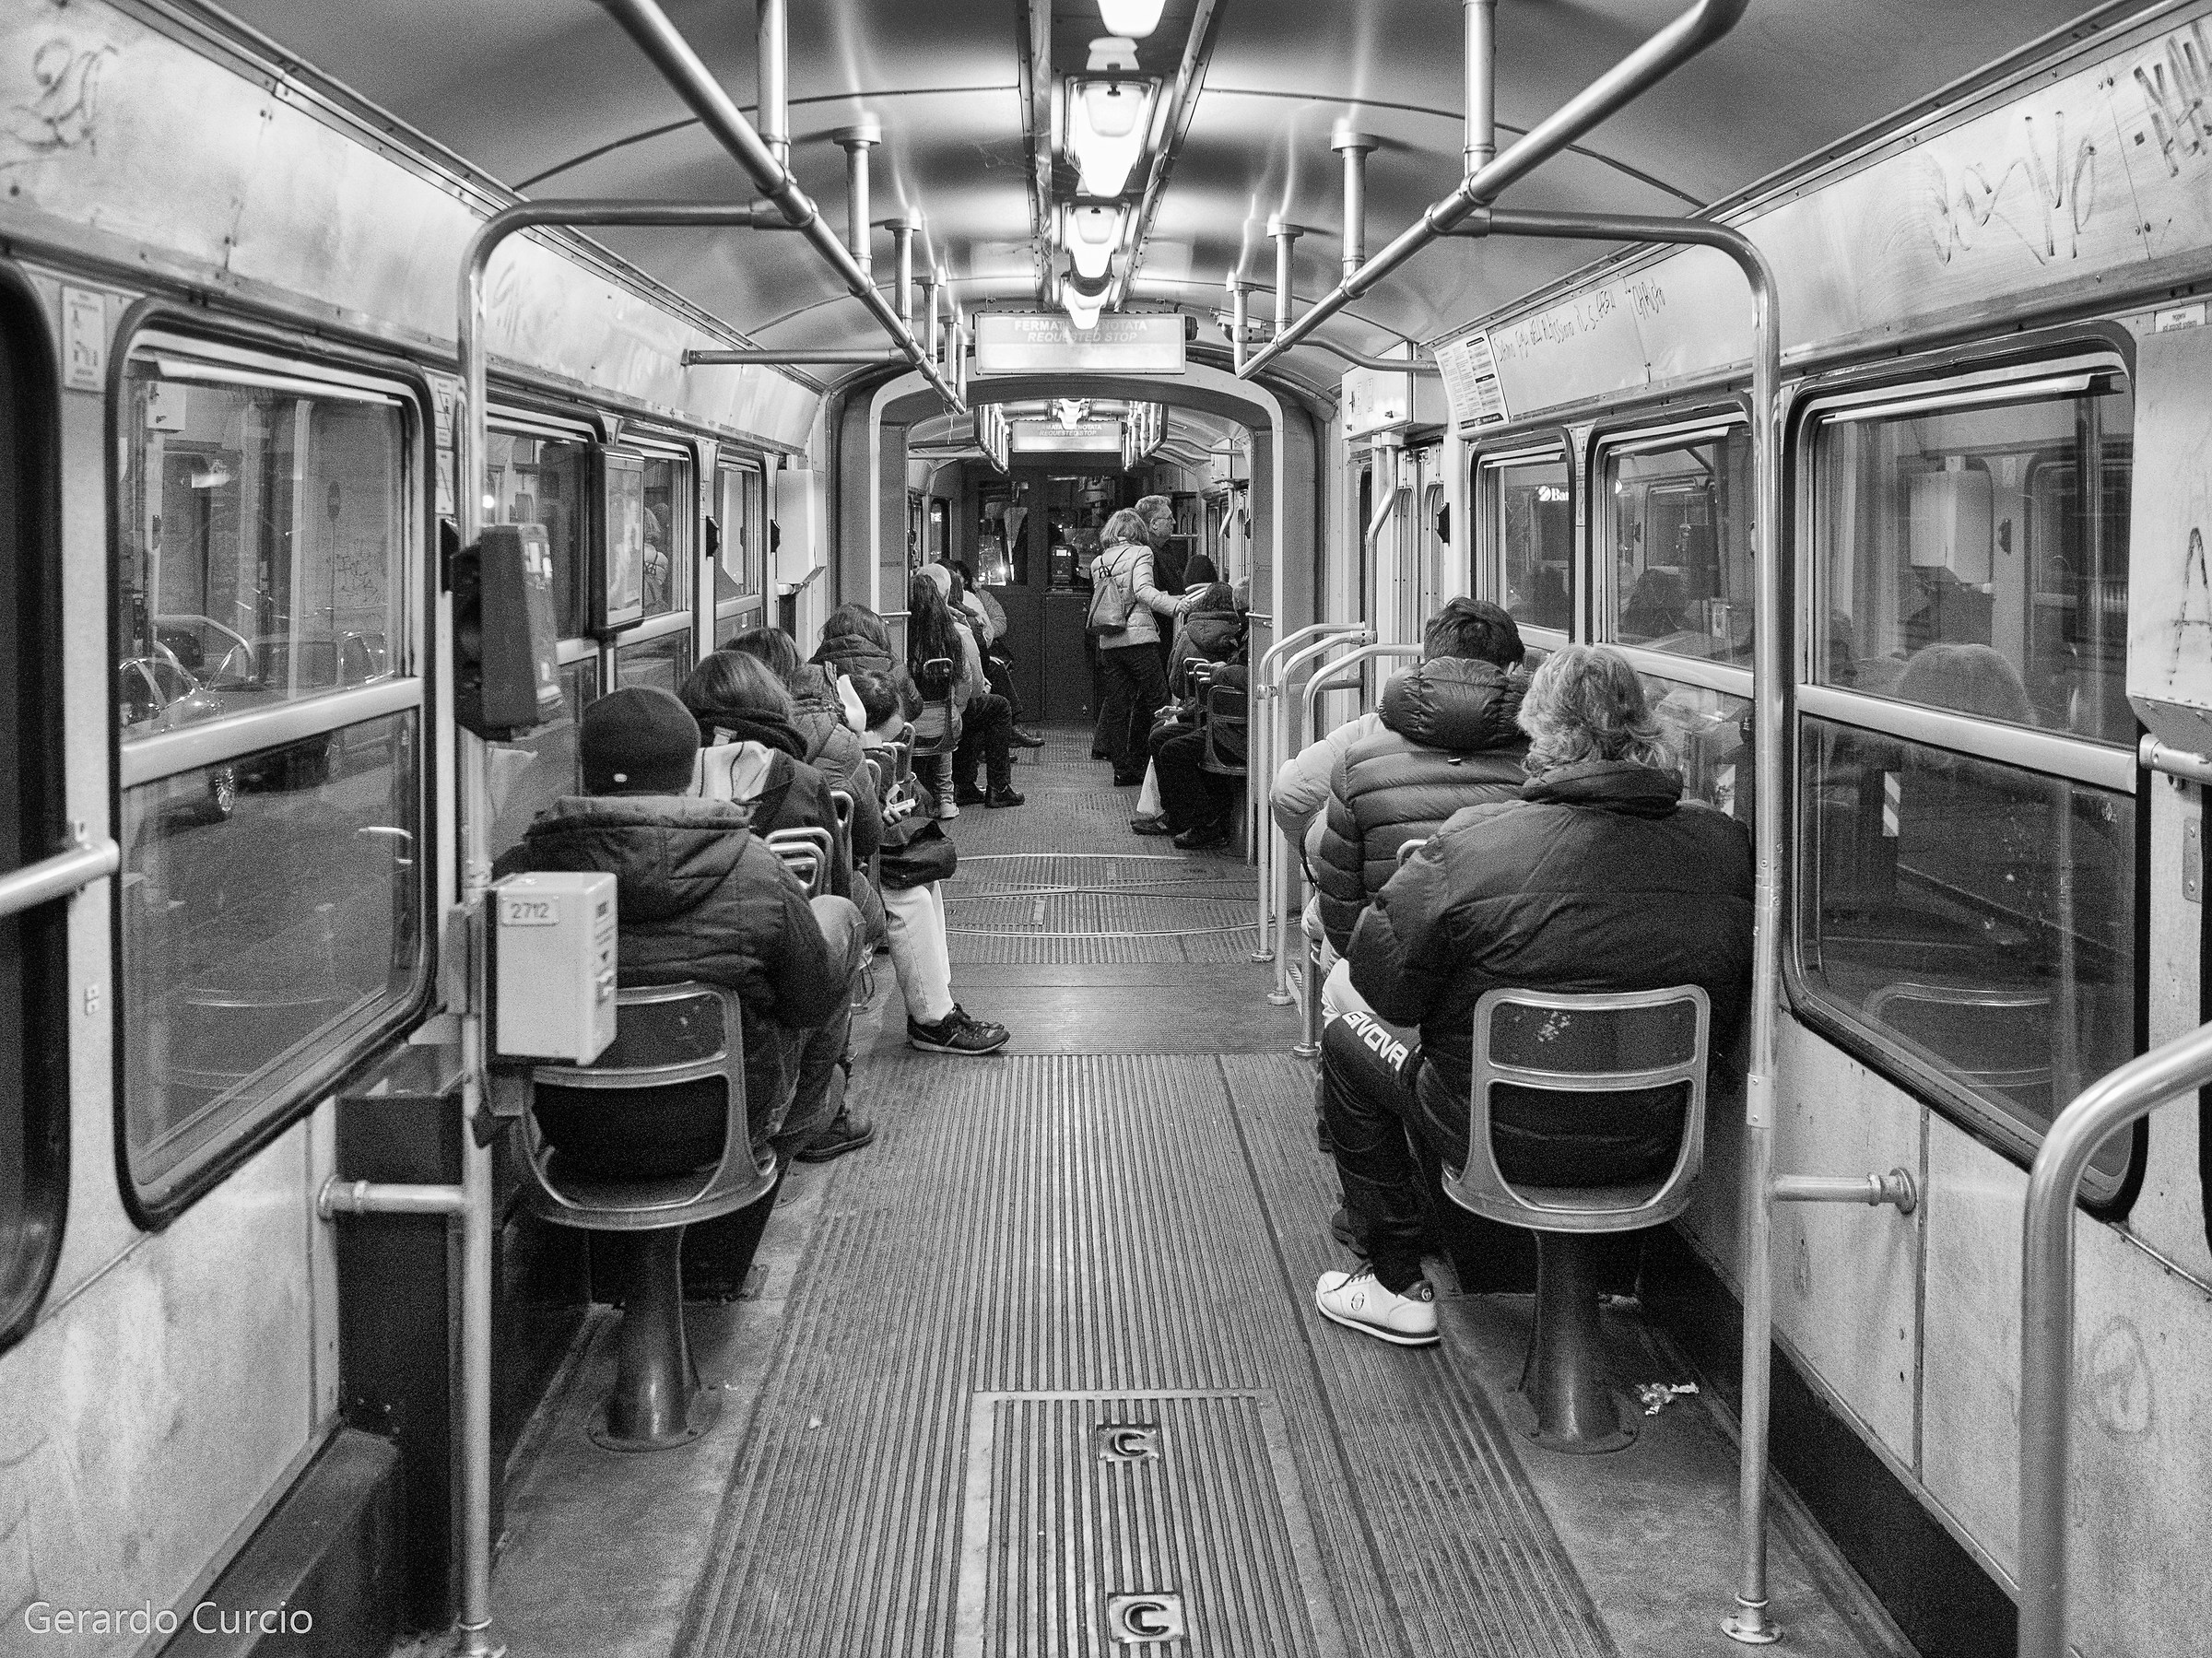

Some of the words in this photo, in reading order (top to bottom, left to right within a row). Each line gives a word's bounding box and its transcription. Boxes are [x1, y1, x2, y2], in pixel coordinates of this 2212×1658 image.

[1027, 332, 1101, 344] REQUESTED
[1104, 332, 1138, 344] STOP
[510, 902, 550, 920] 2712
[1341, 1010, 1409, 1072] GIVOVA
